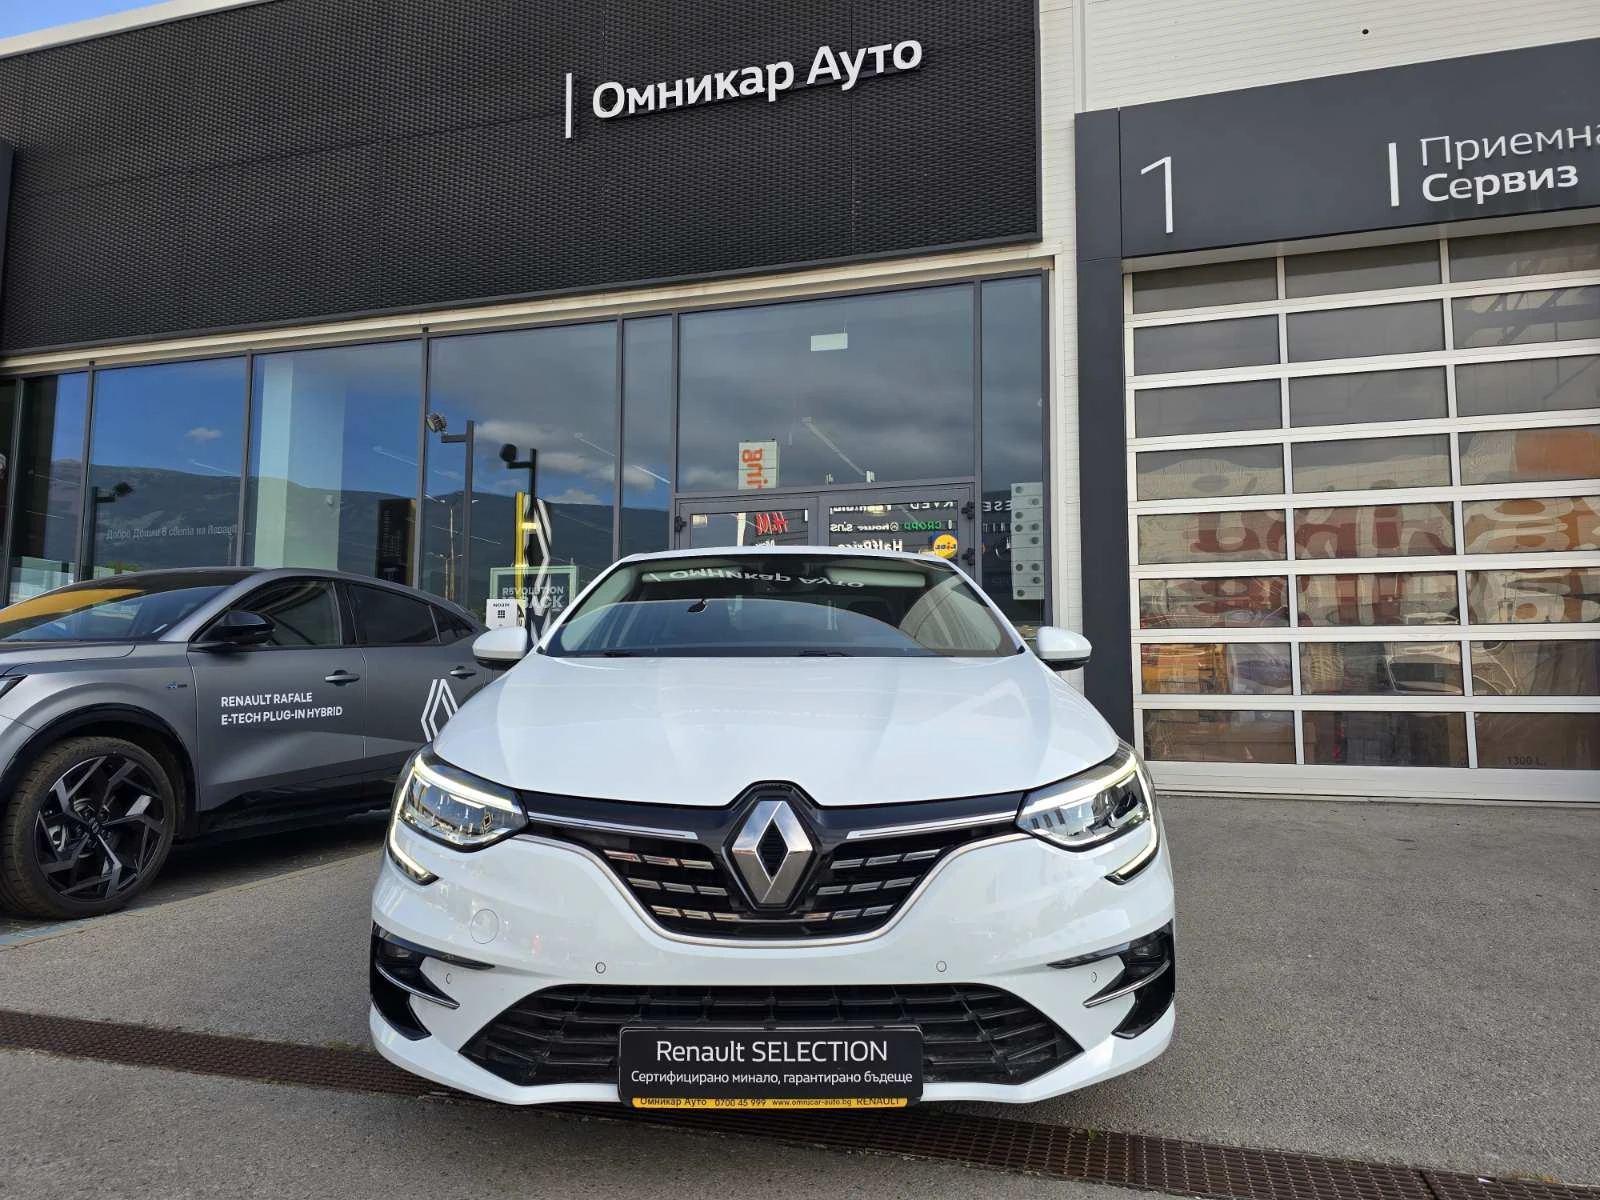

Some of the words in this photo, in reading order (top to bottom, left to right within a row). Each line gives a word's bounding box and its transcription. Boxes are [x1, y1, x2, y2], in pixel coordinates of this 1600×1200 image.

[592, 61, 795, 118] Омникар
[806, 40, 923, 91] Ауто
[1420, 123, 1600, 170] Приемн
[1141, 156, 1174, 234] 1
[1421, 165, 1579, 205] Сервиз
[221, 694, 272, 707] RENAULT
[273, 692, 313, 704] RAFALE
[221, 711, 262, 725] E-TECH
[263, 708, 305, 722] PLUG-IN
[306, 706, 343, 718] HYBRID
[656, 1040, 745, 1062] Renault
[752, 1040, 888, 1062] SELECTION
[631, 1070, 730, 1085] Сертифицирано
[732, 1072, 781, 1085] минало,
[783, 1072, 862, 1085] гарантирано
[864, 1070, 913, 1084] бъдеще
[685, 1099, 707, 1107] Ауто
[856, 1097, 900, 1106] RENAULT
